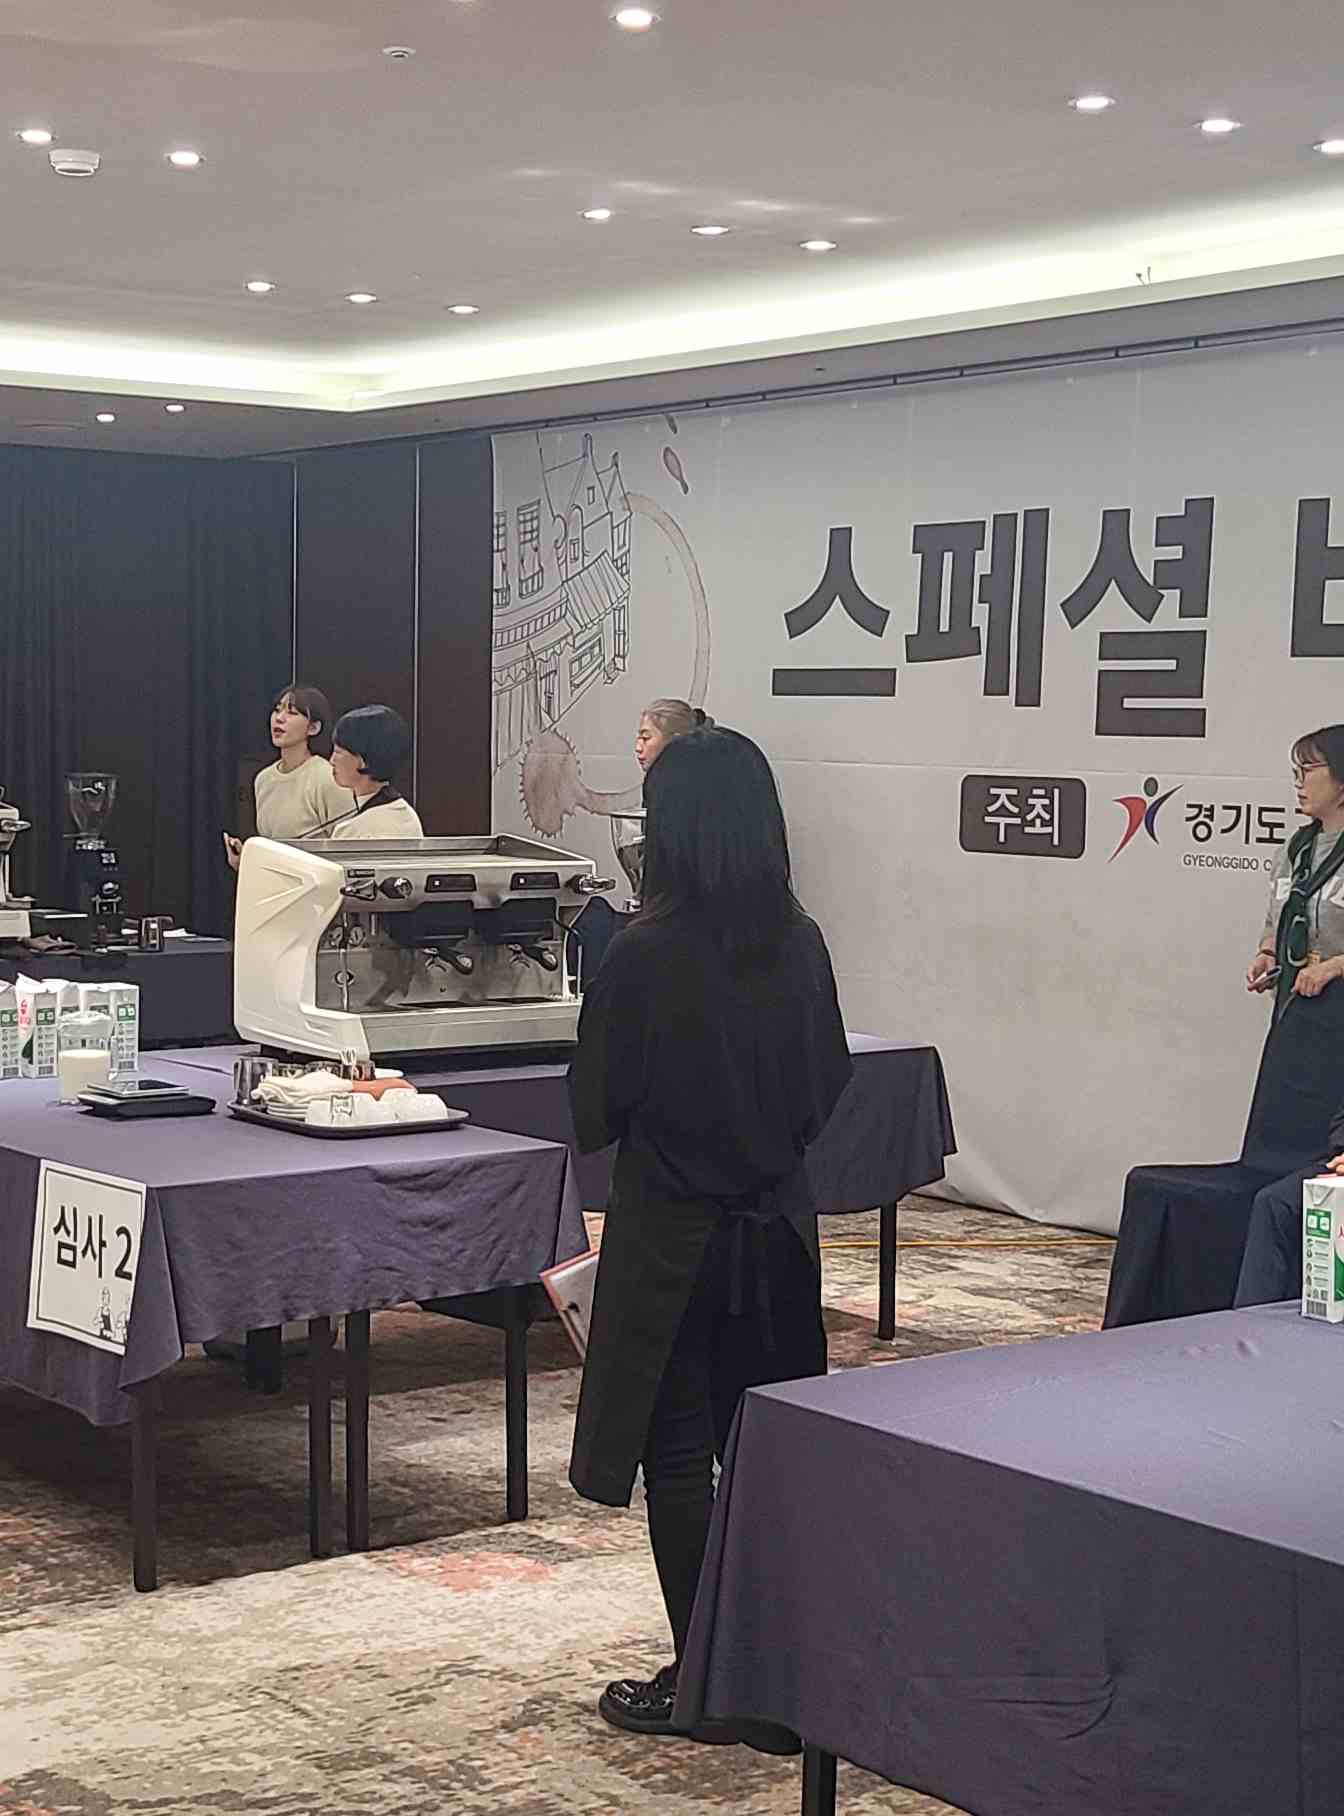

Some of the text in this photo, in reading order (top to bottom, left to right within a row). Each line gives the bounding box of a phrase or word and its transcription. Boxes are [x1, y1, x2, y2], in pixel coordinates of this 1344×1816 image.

[771, 495, 1216, 738] 스페셜
[983, 787, 1060, 847] 주최
[1183, 854, 1259, 871] GYEONGGIDO
[53, 1205, 133, 1281] 심사 2
